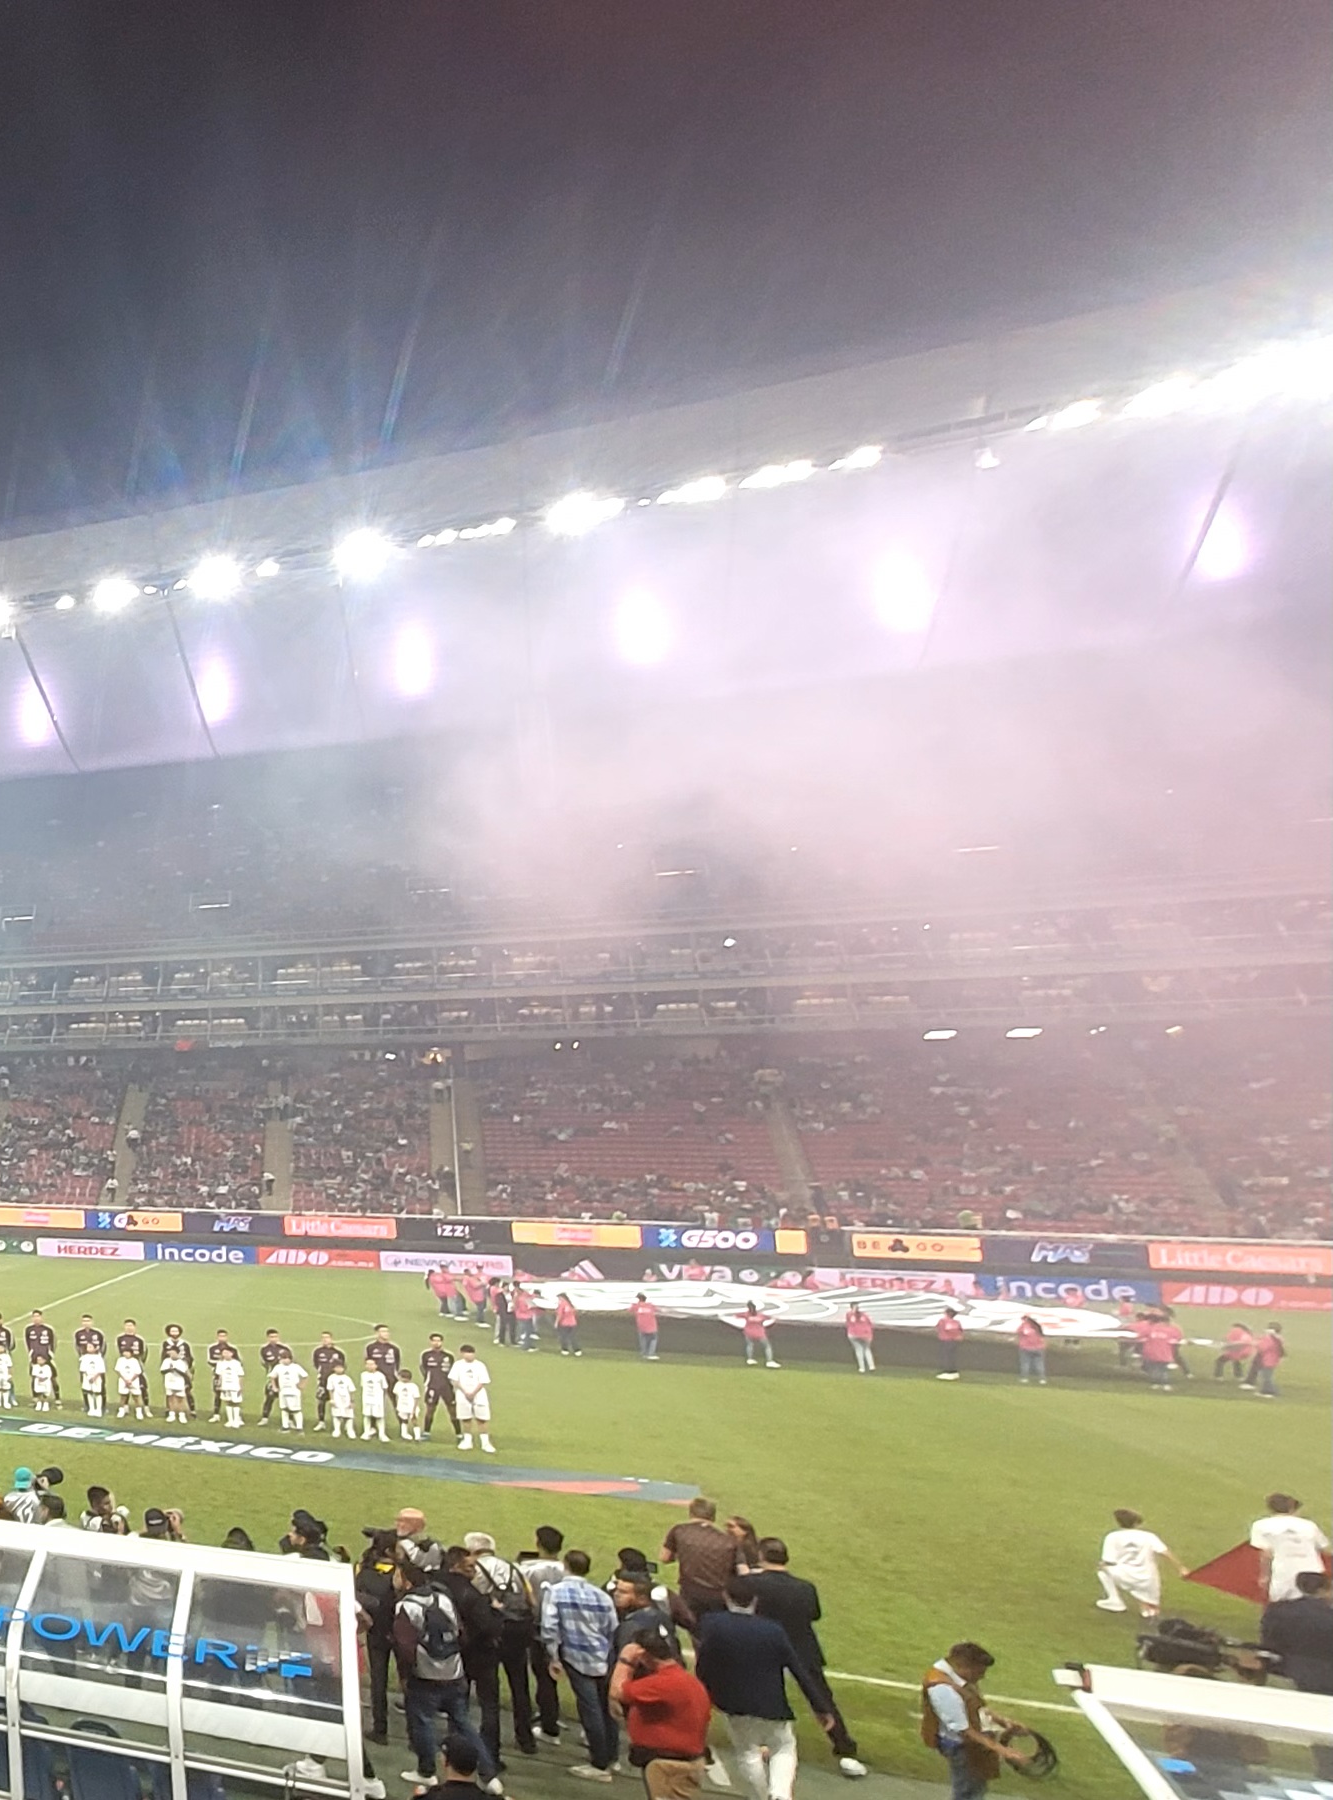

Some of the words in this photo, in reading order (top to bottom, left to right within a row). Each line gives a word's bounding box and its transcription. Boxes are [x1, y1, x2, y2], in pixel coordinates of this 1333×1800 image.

[681, 1229, 758, 1249] G500
[56, 1244, 121, 1257] HERDEZ
[156, 1243, 245, 1263] incode
[265, 1249, 329, 1265] ADO
[1159, 1248, 1221, 1267] Little
[1225, 1250, 1323, 1271] Caesars
[404, 1257, 457, 1268] NEVADA
[457, 1258, 504, 1270] TOURS
[1171, 1284, 1274, 1306] ADO
[19, 1422, 104, 1439] DE
[104, 1431, 335, 1463] MÉXICO
